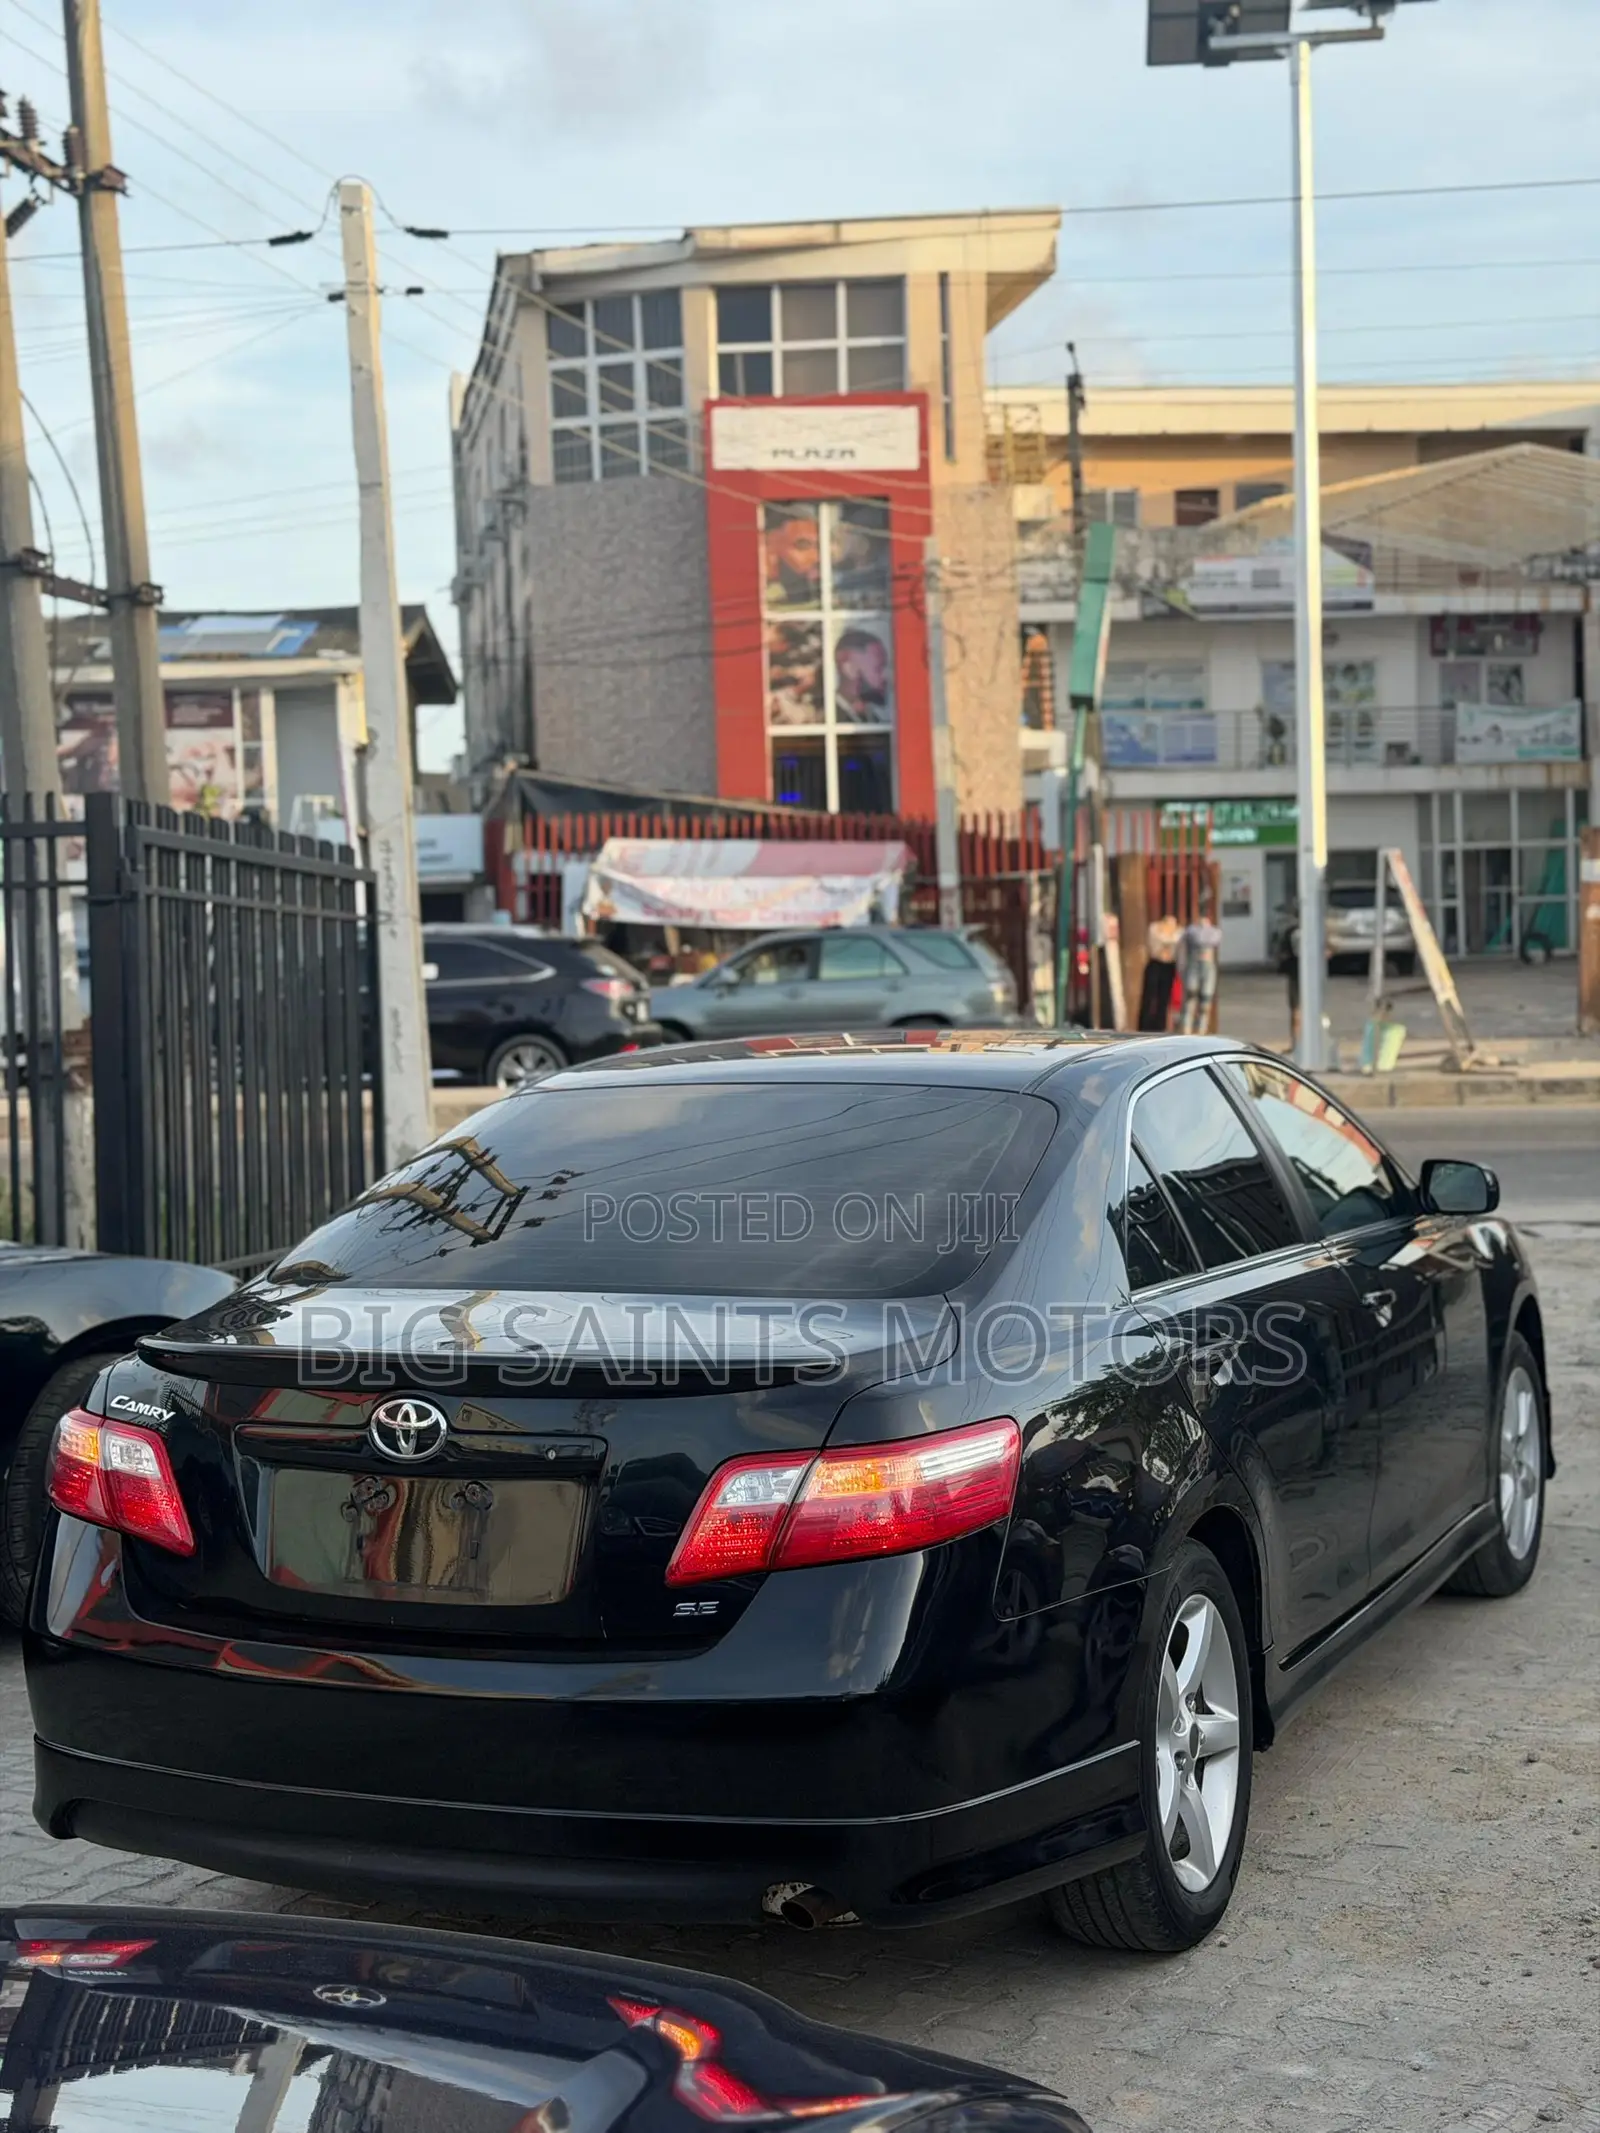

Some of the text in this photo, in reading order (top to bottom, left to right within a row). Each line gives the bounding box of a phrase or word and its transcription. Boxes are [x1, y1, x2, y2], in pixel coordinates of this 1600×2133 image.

[772, 448, 856, 459] PLAZA
[110, 1395, 176, 1422] CAMRY
[673, 1601, 720, 1616] SE
